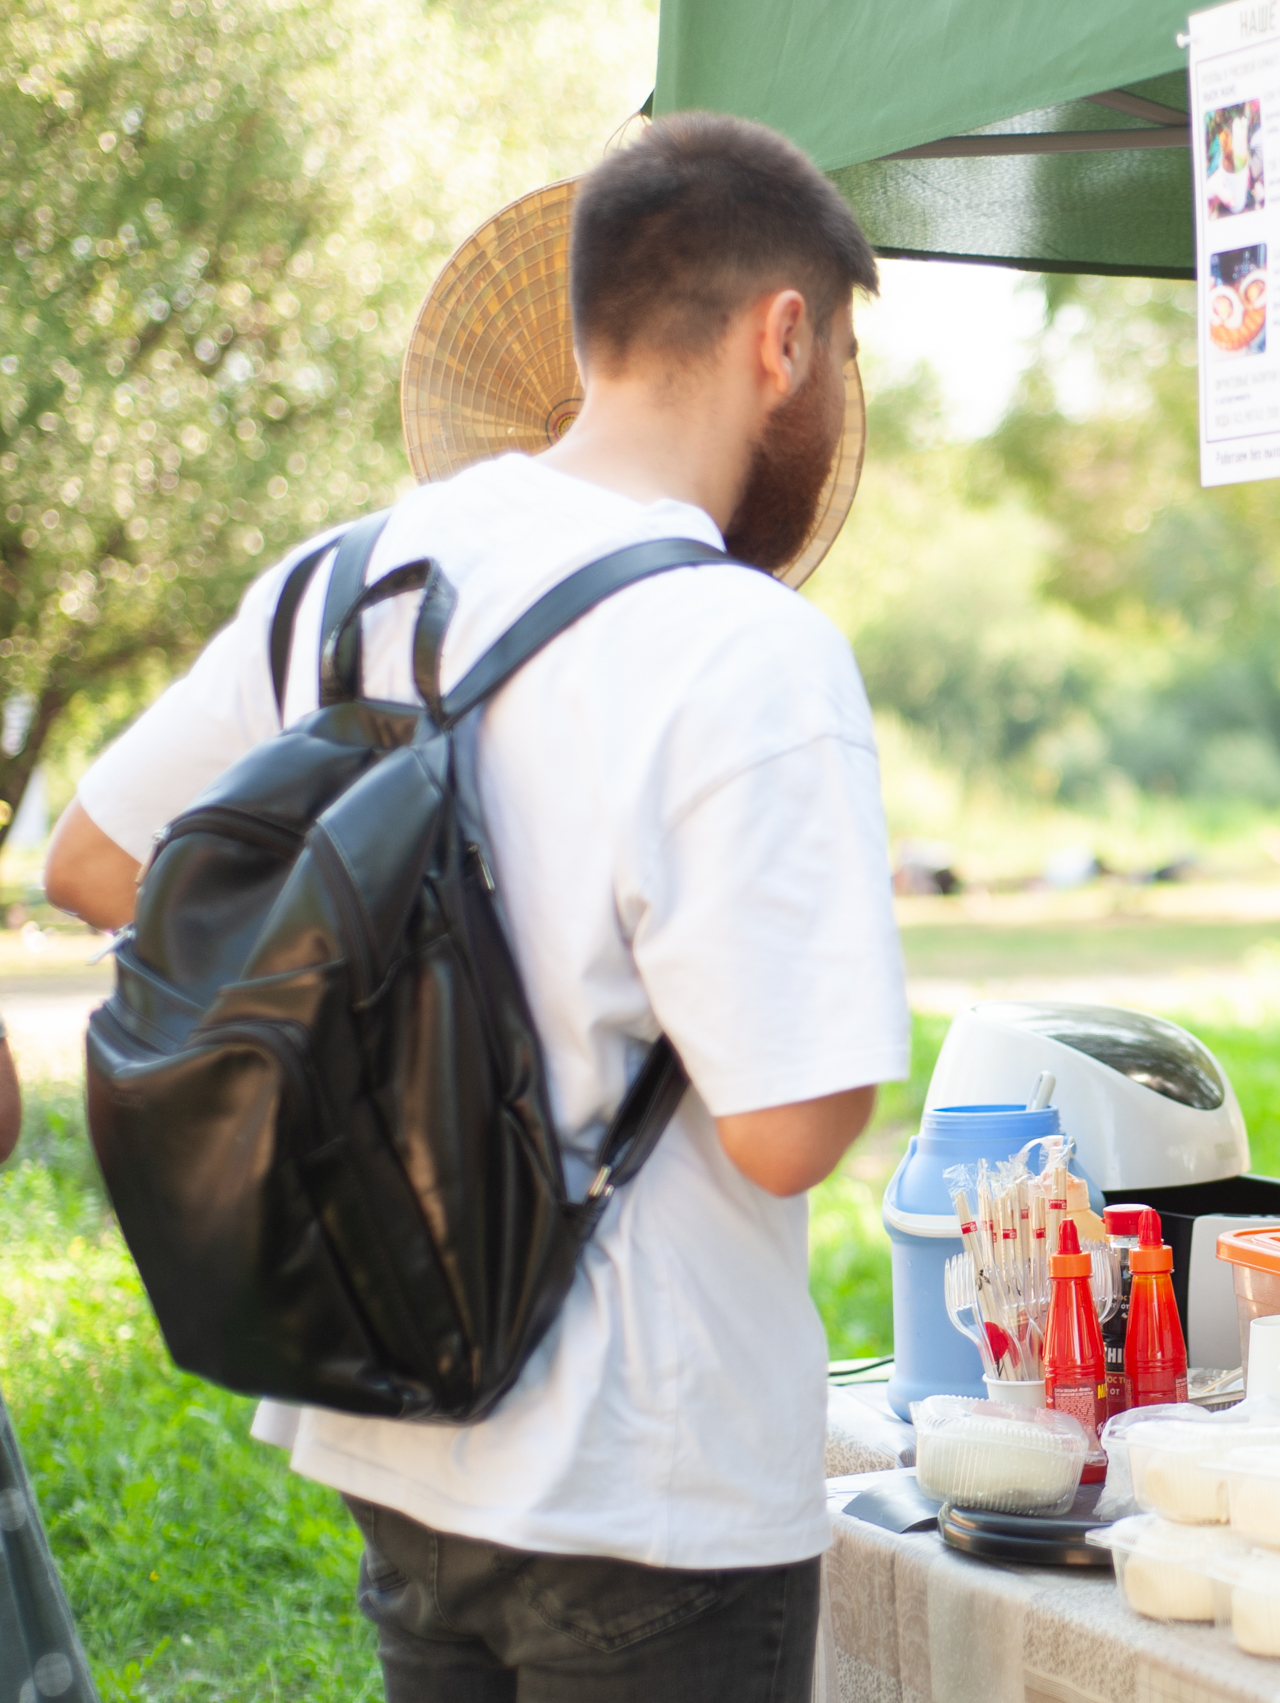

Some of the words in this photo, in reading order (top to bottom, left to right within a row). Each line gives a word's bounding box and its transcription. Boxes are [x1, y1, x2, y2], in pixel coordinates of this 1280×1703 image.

[1240, 1, 1277, 38] НАШЕ
[1216, 447, 1247, 465] Работаем
[1249, 446, 1262, 461] без
